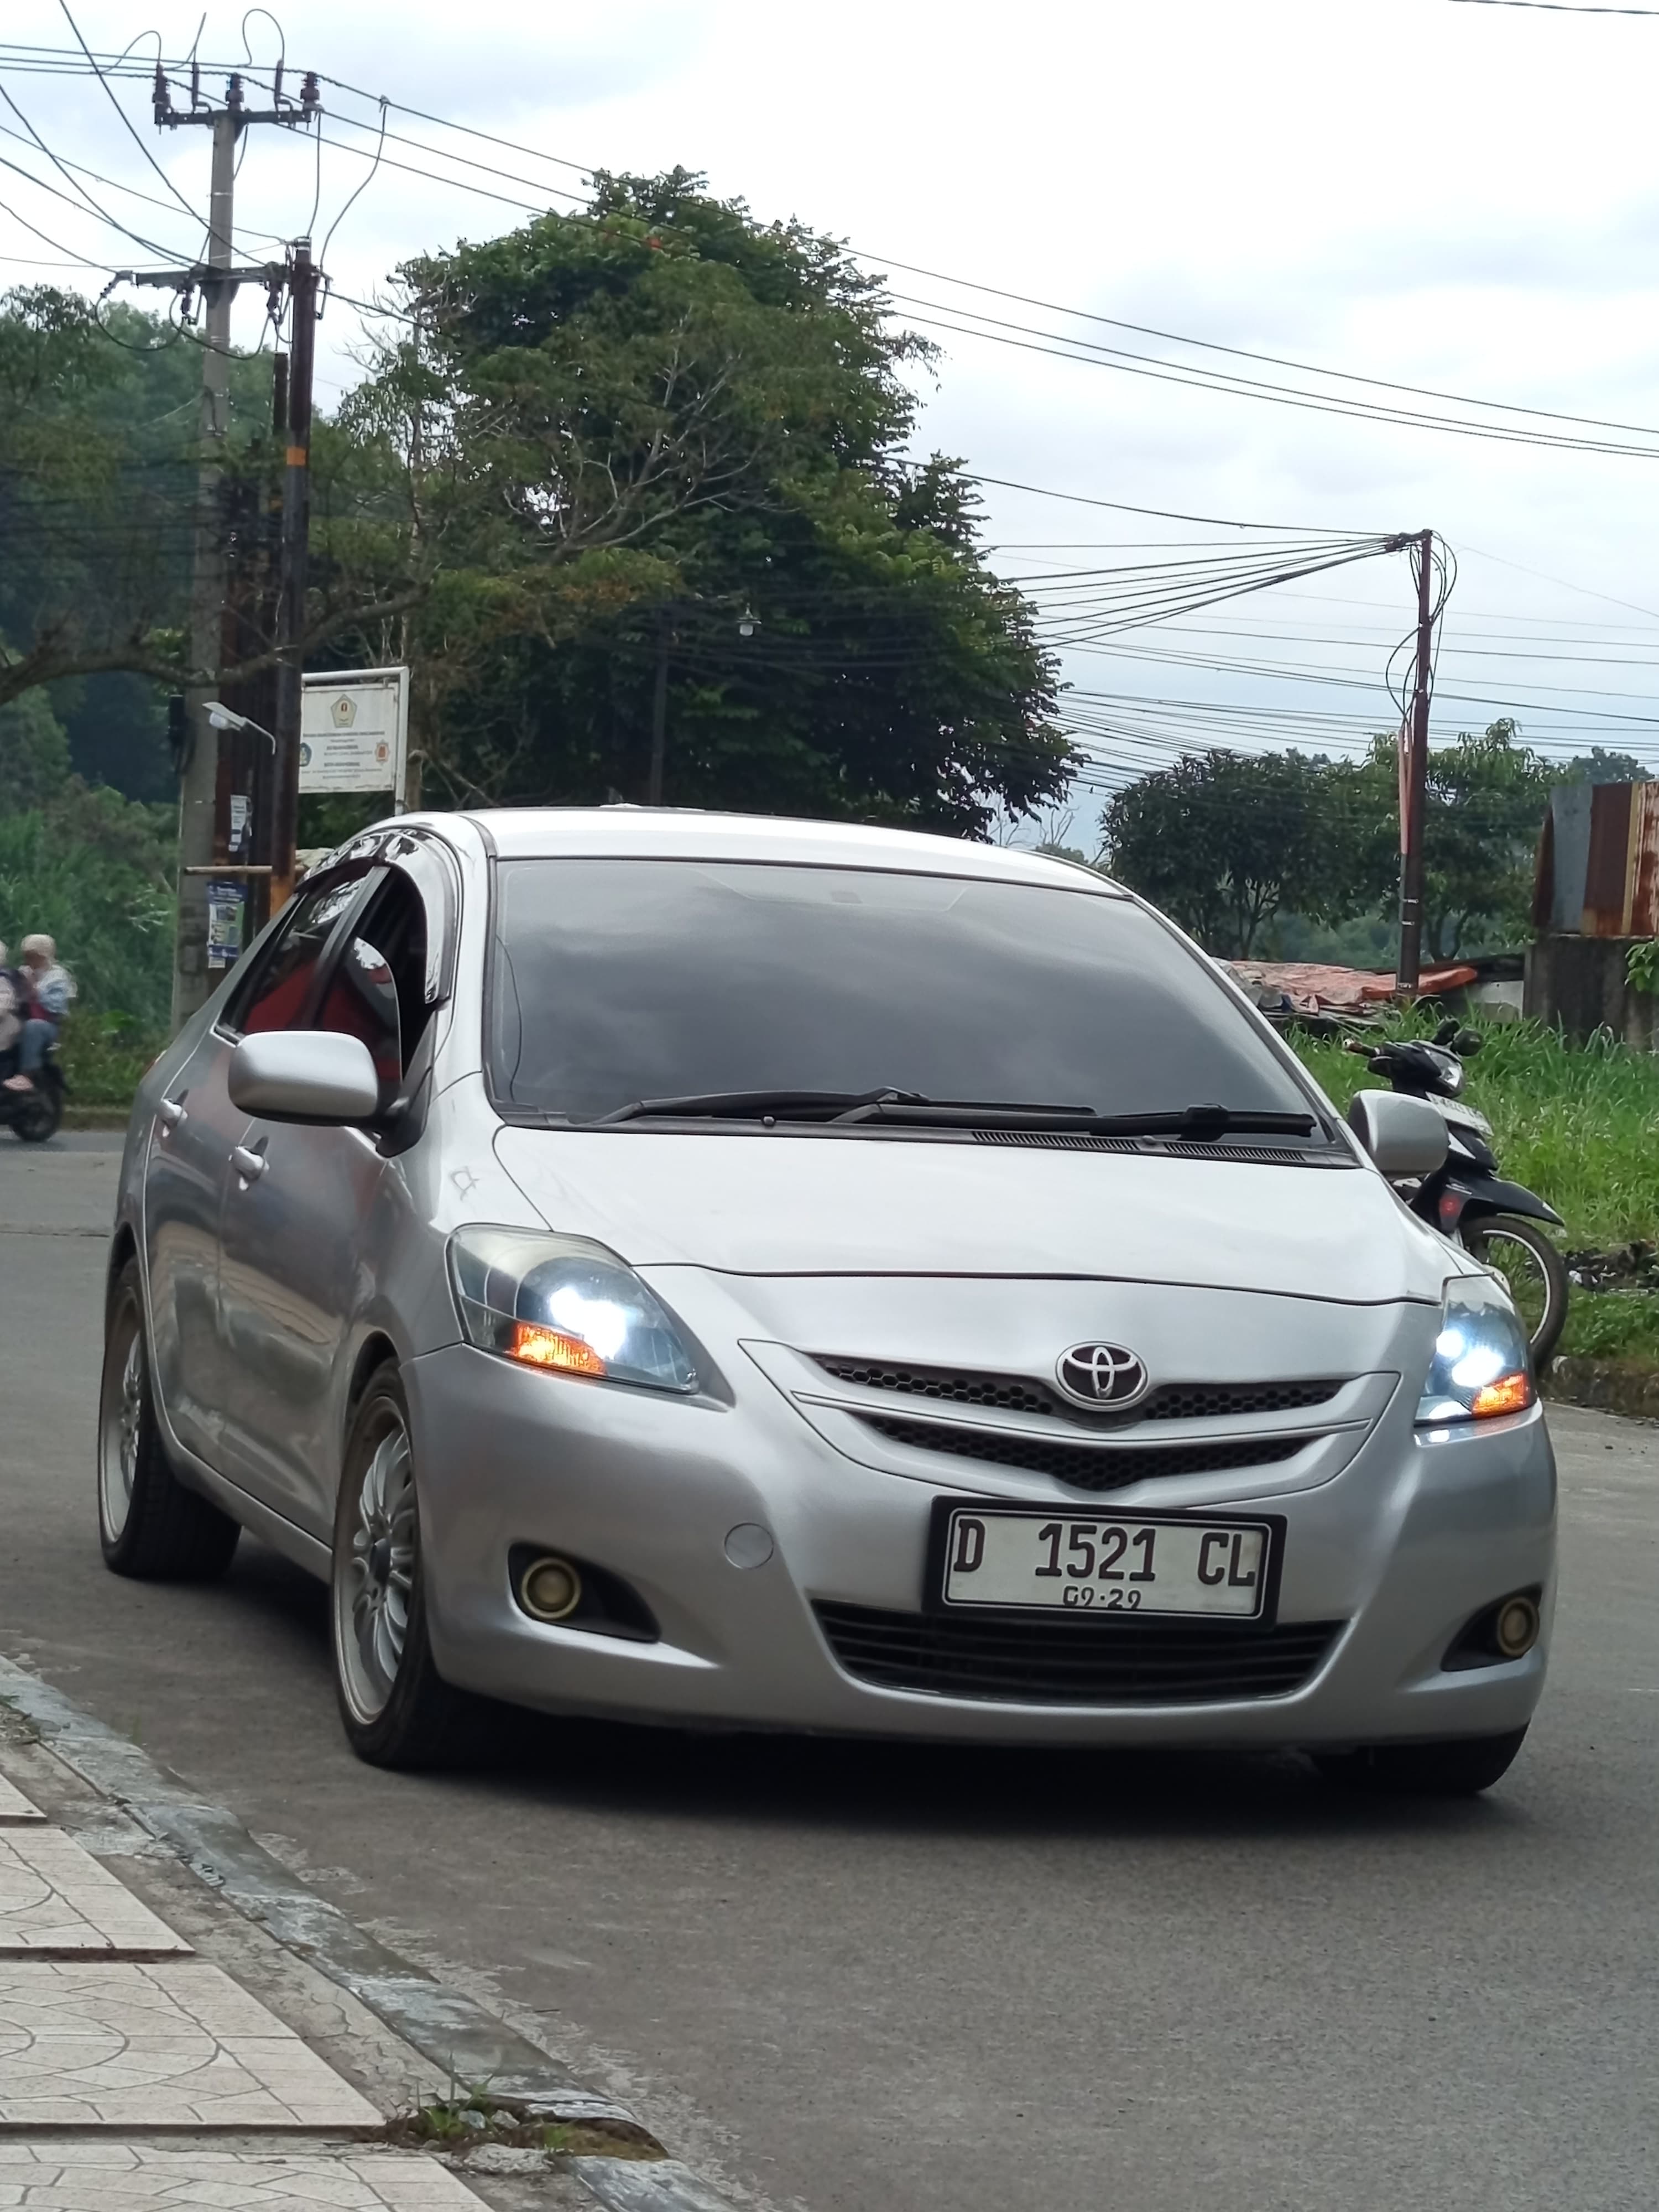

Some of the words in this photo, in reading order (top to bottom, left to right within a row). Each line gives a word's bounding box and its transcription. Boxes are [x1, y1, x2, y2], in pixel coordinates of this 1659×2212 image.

[953, 1518, 985, 1572] D
[1035, 1522, 1156, 1582] 1521
[1197, 1531, 1256, 1587] CL
